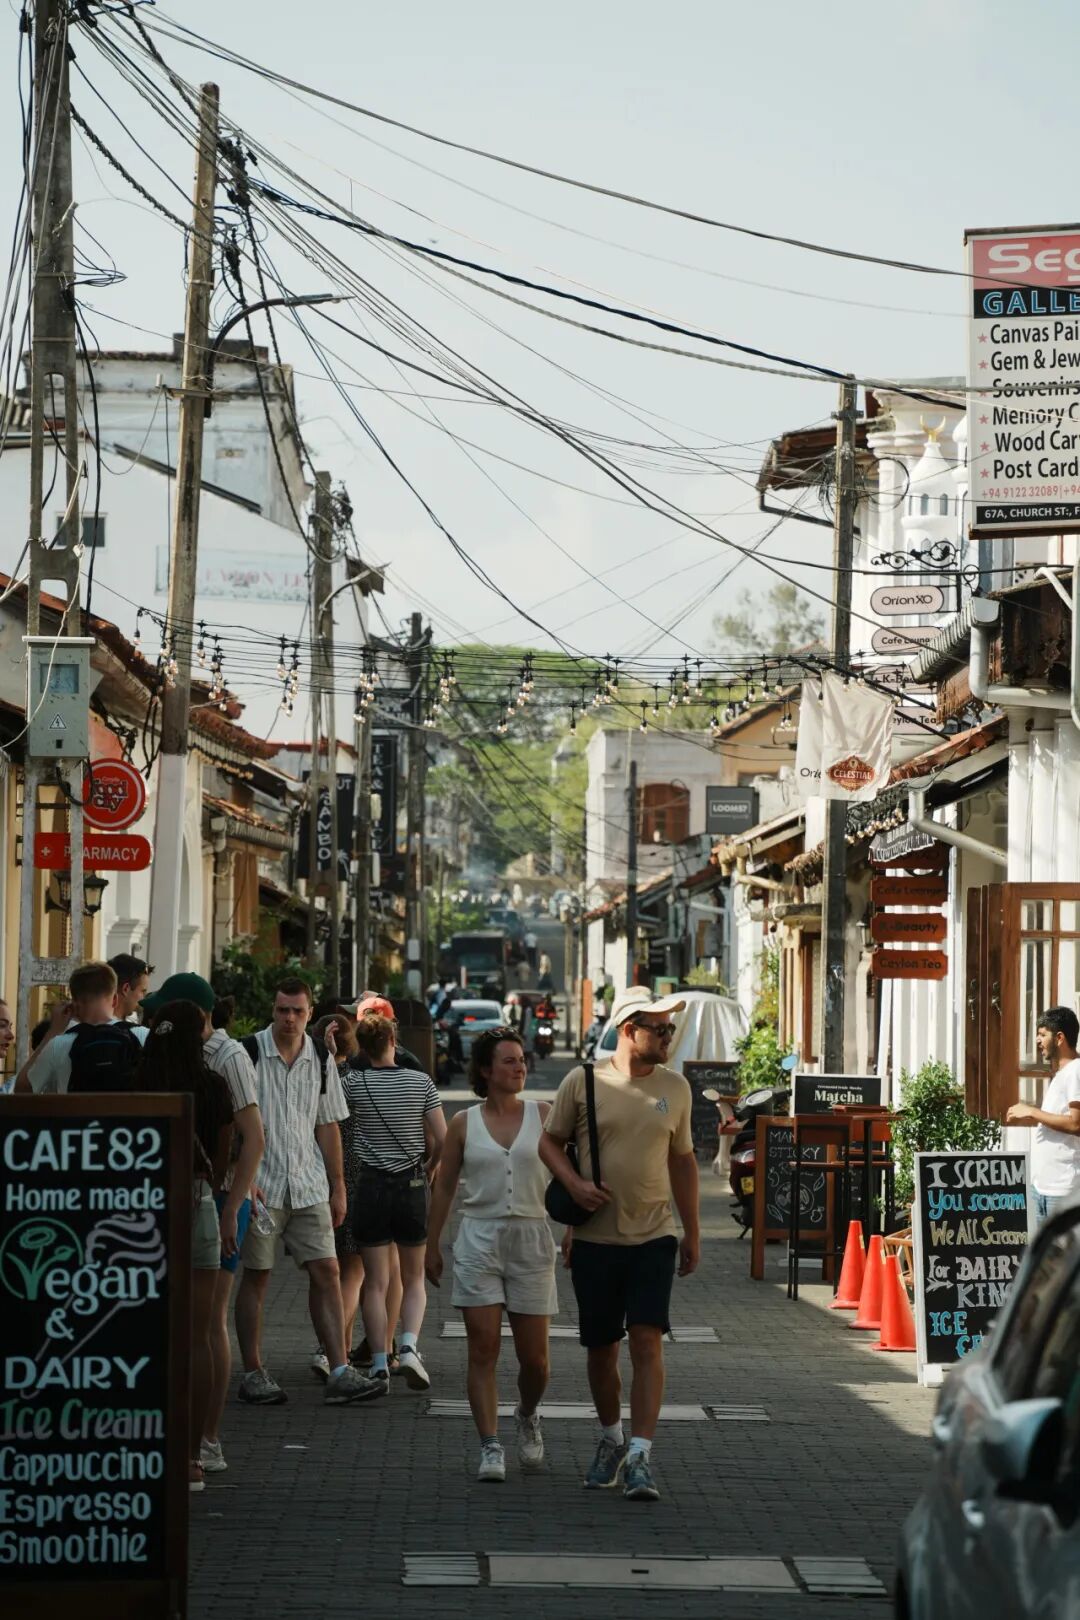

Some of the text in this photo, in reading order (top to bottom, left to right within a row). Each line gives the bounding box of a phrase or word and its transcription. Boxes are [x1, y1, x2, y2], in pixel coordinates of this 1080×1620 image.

[990, 323, 1050, 344] Canvas
[991, 351, 1028, 371] Gem
[1033, 349, 1046, 369] &
[992, 406, 1065, 428] Memory
[995, 430, 1080, 452] Wood Car
[994, 456, 1079, 479] Post Card
[1009, 507, 1053, 519] CHURCH
[881, 637, 902, 645] Cafe
[834, 770, 871, 780] CELESTIAL
[65, 846, 139, 861] PARMACY
[814, 1090, 863, 1104] Matcha
[3, 1120, 163, 1172] CAFÉ 82
[926, 1162, 948, 1189] I
[5, 1177, 165, 1211] Home made
[930, 1221, 954, 1247] We
[45, 1307, 75, 1341] &
[929, 1311, 968, 1337] ICE
[4, 1356, 150, 1390] DAIRY
[0, 1398, 165, 1441] Ice Cream
[0, 1446, 164, 1487] Cappuccino
[0, 1489, 152, 1528] Espresso
[0, 1526, 148, 1564] Smoothie
